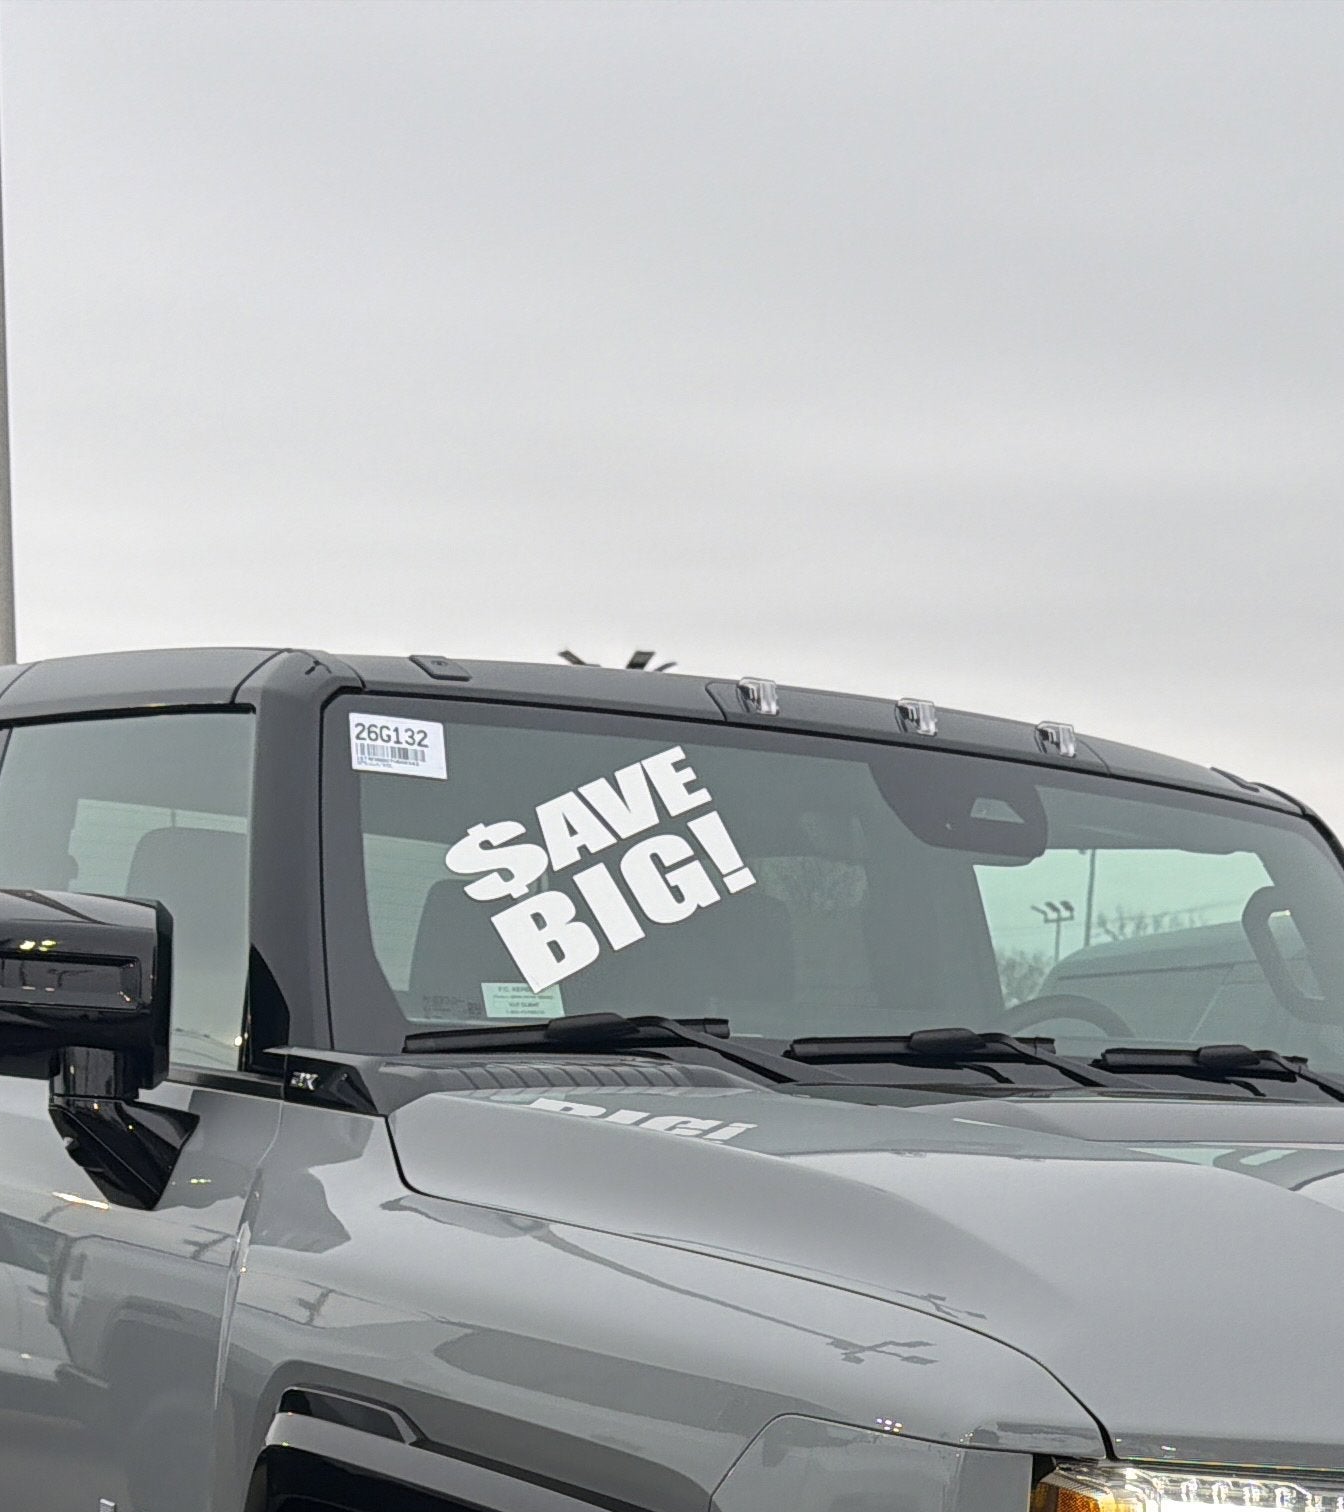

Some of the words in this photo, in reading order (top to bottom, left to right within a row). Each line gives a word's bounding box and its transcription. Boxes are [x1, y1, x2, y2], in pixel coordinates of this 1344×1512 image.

[354, 722, 429, 748] 26G132
[445, 745, 713, 901] $AVE
[490, 811, 757, 994] BIG!
